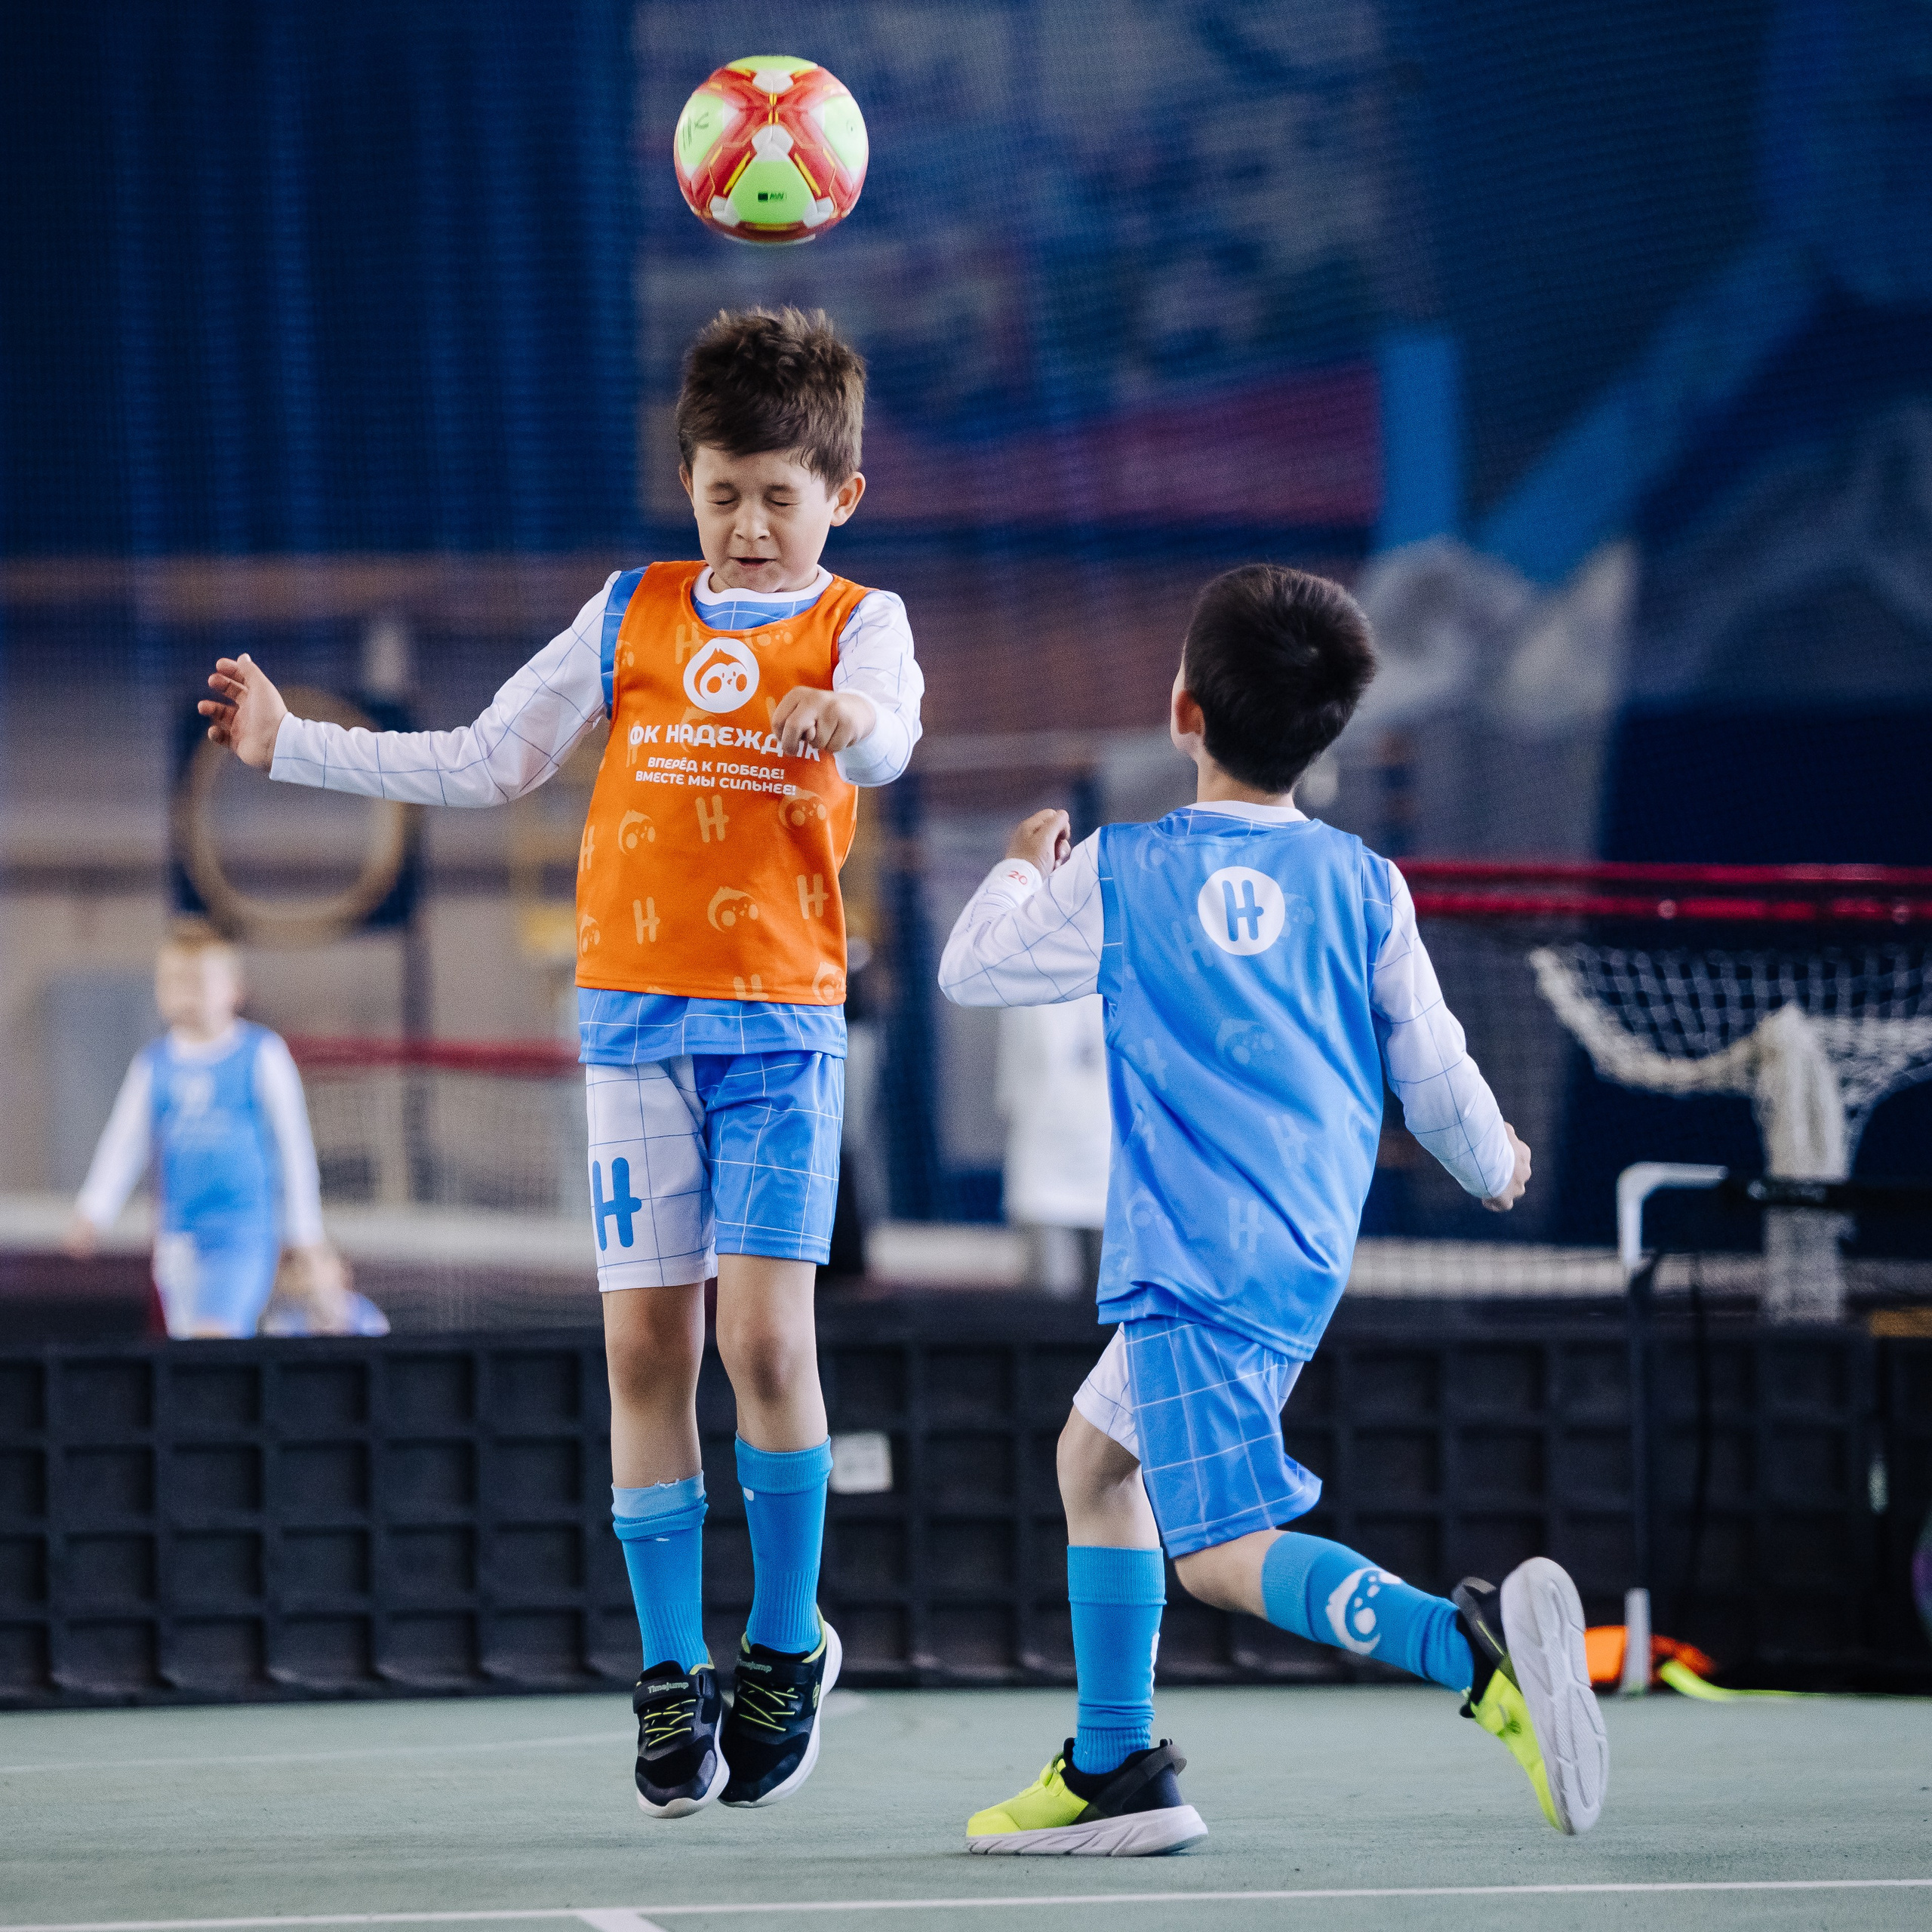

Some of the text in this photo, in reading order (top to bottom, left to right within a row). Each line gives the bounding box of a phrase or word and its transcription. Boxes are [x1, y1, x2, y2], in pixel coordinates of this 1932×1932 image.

[629, 723, 820, 762] ФК НАДЕЖДК
[648, 756, 785, 780] ВПЕРЁД К ПОБЕДЕ!
[635, 770, 796, 796] ВМЕСТЕ МЫ СИЛЬНЕЕ!
[1008, 870, 1028, 885] 20
